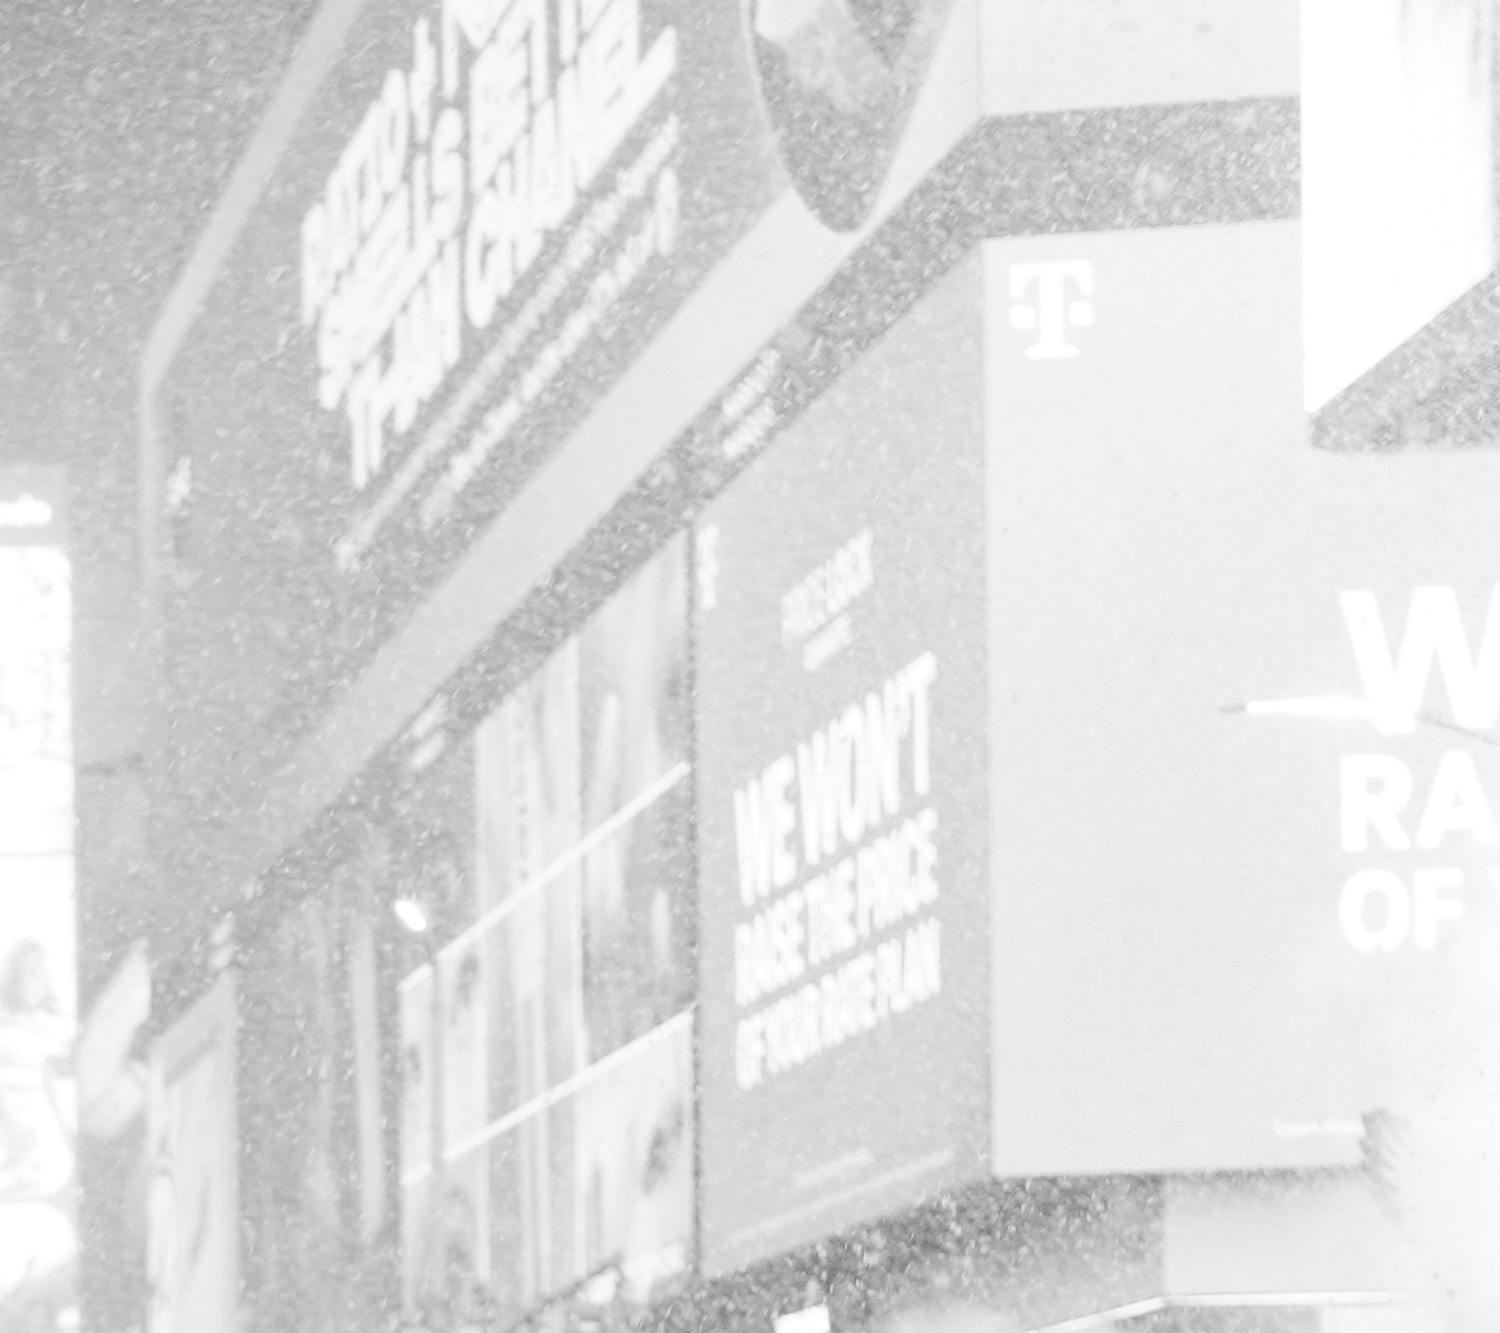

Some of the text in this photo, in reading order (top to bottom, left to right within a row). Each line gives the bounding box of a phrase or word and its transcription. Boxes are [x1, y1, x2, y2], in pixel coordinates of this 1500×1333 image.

[734, 651, 937, 907] WE WON'T
[1339, 866, 1465, 953] OF
